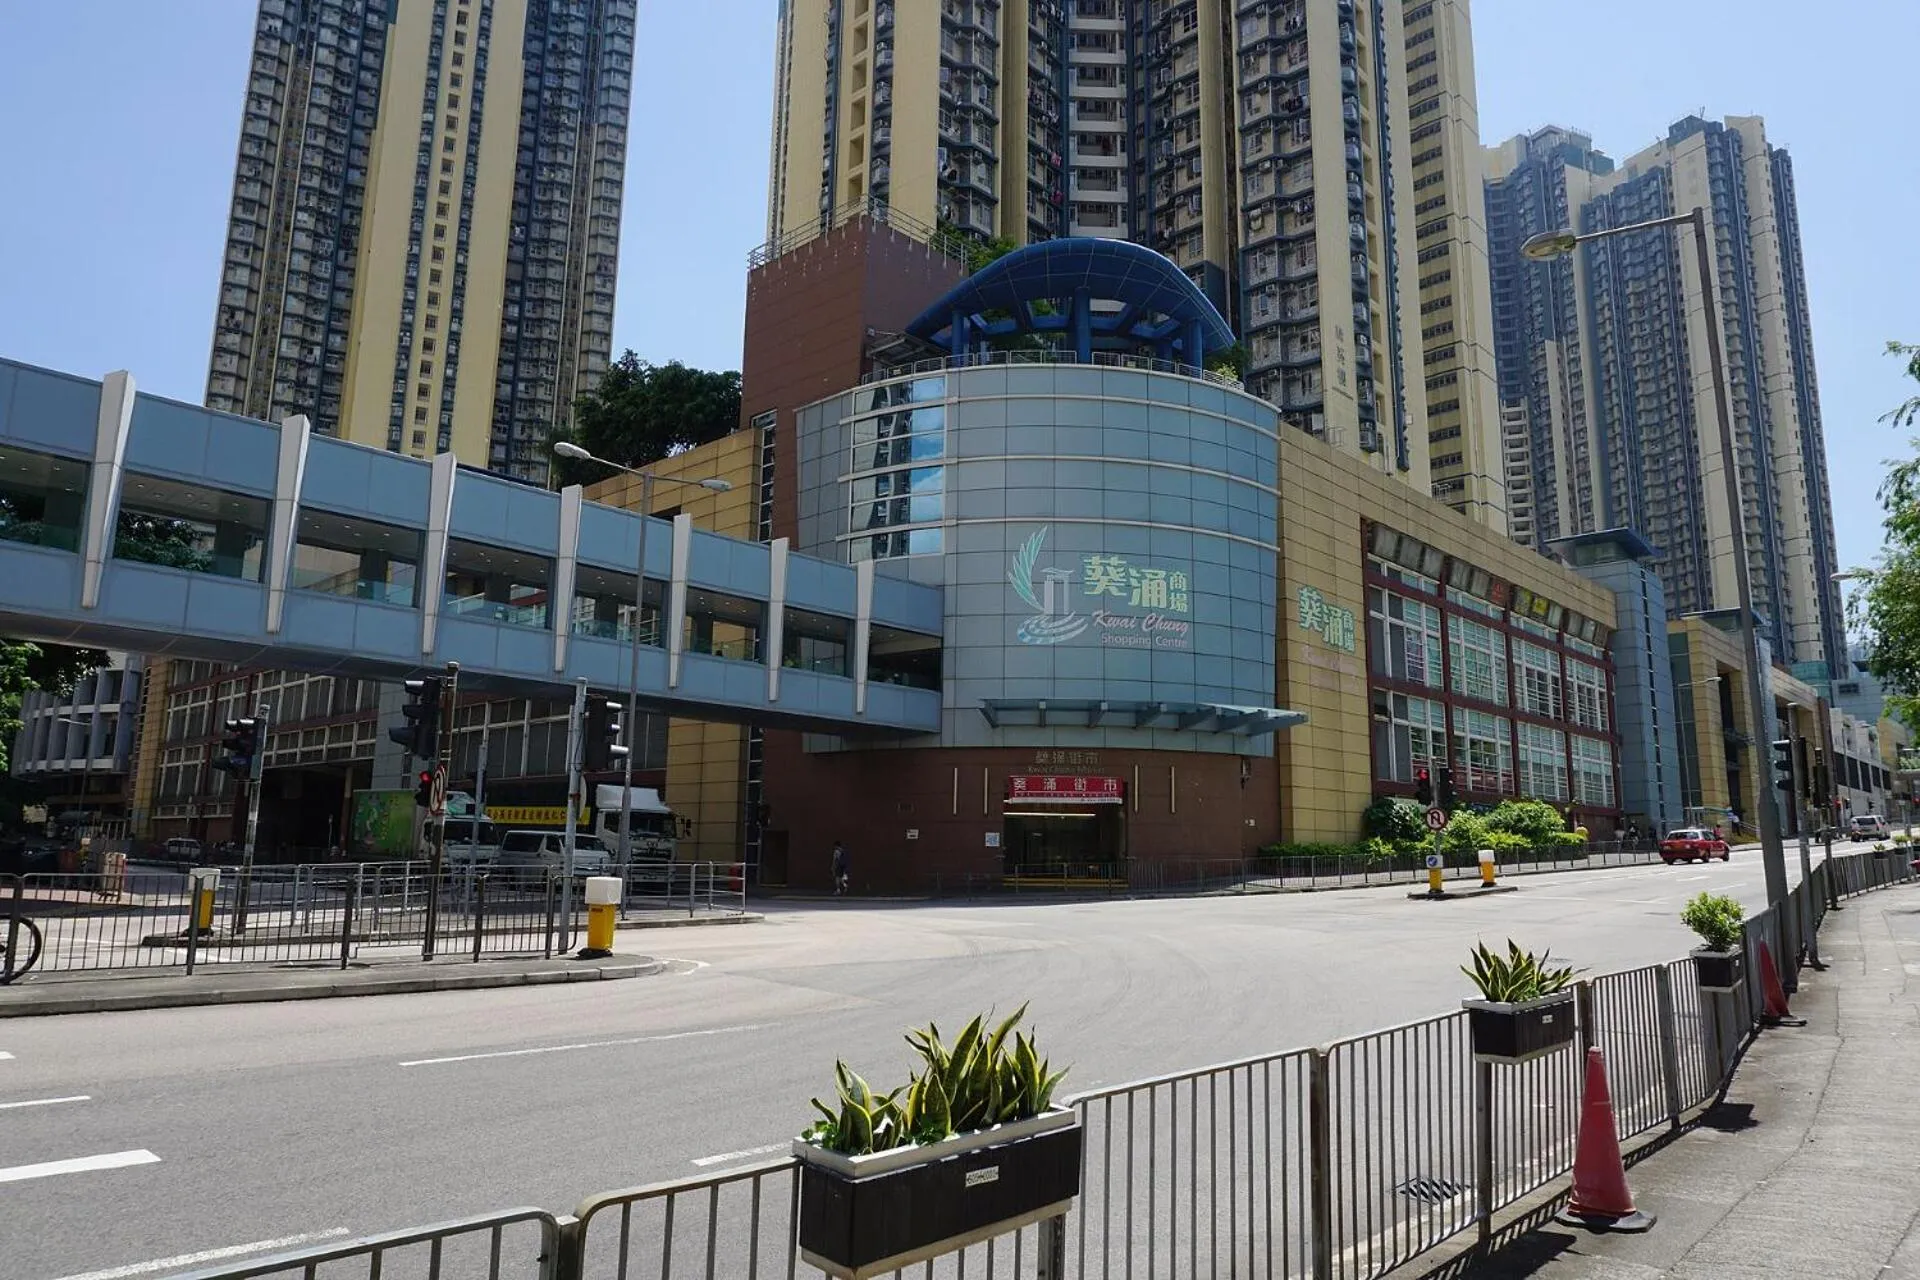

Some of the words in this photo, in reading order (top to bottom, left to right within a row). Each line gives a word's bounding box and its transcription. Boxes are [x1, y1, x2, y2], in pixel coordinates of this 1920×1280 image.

[1091, 610, 1136, 629] Kwai
[1141, 613, 1189, 637] Chung
[1101, 632, 1152, 646] Shopping
[1155, 635, 1188, 648] Centre
[1013, 776, 1117, 792] 葵涌街市
